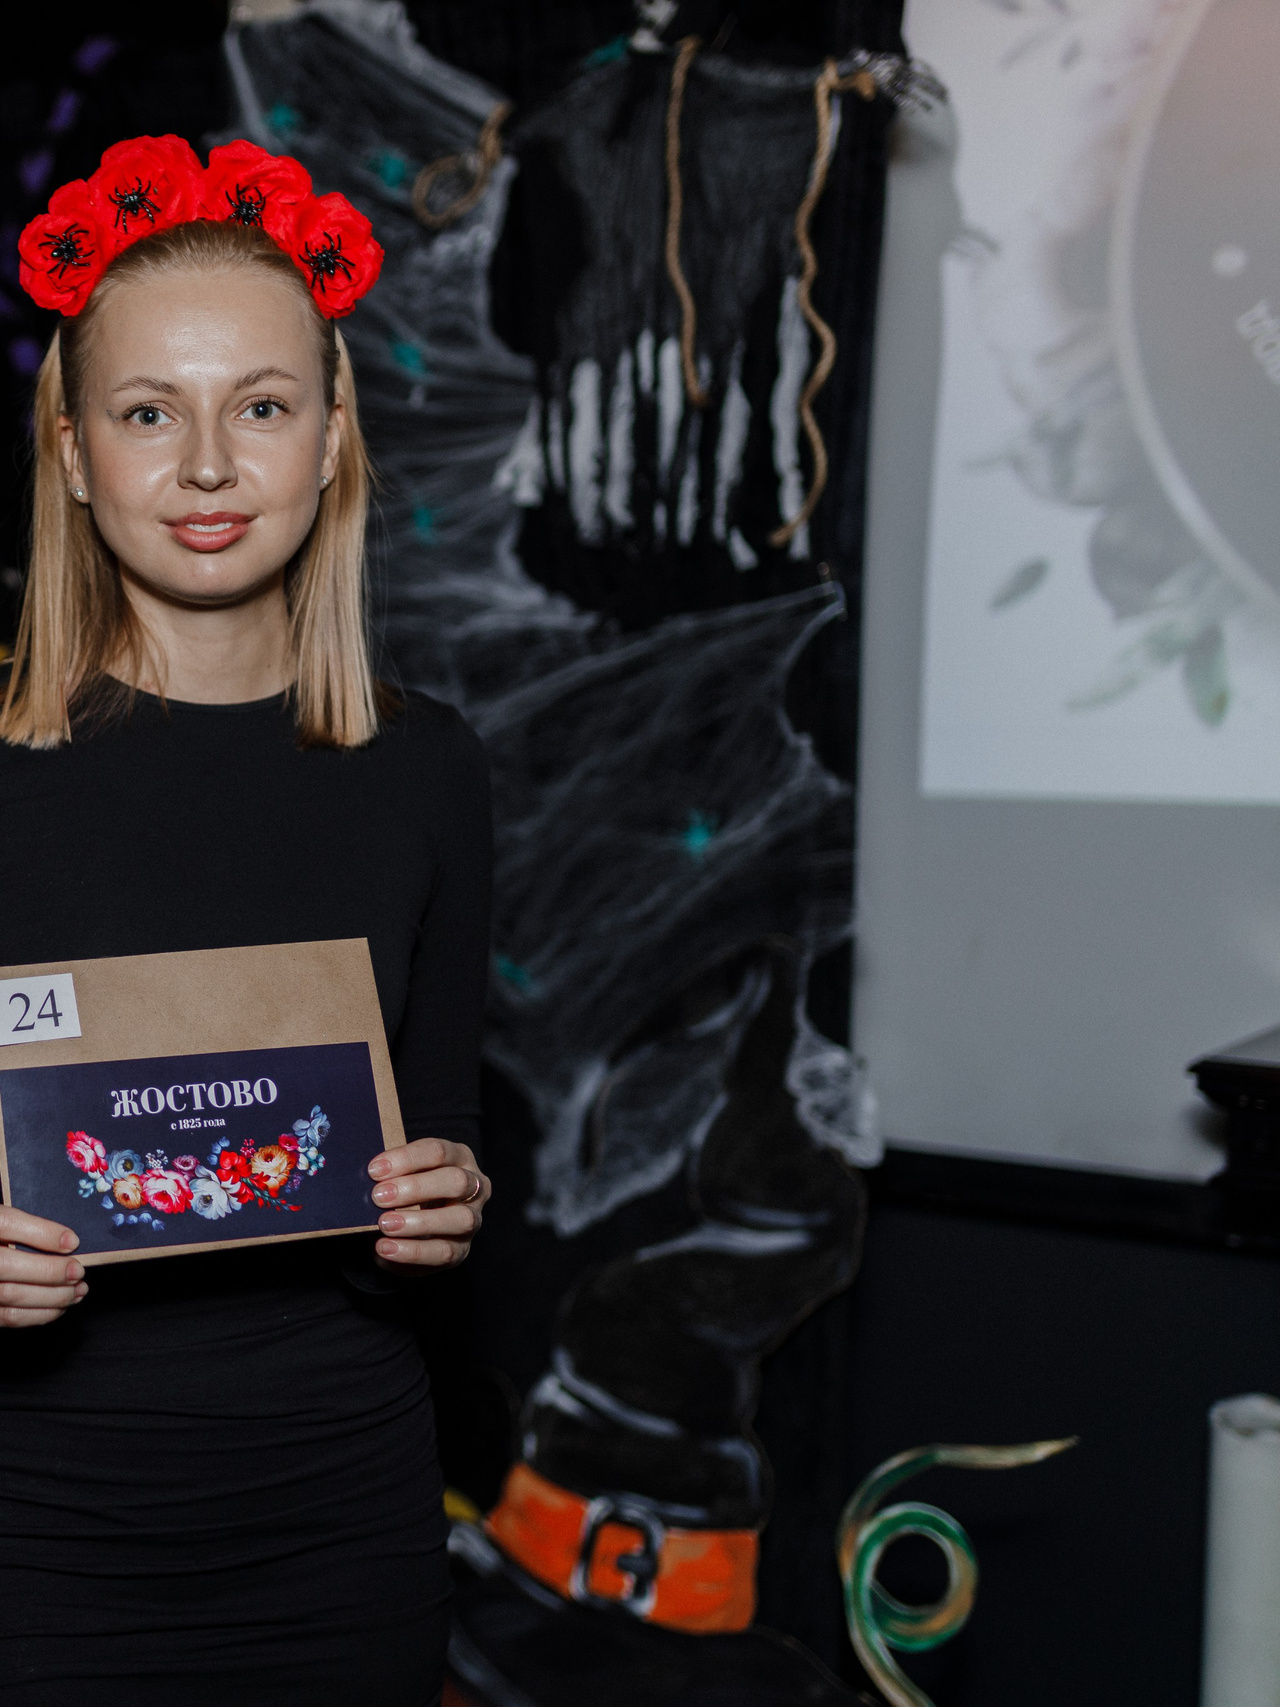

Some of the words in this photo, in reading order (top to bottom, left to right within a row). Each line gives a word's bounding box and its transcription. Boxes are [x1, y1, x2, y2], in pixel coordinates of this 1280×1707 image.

[8, 989, 63, 1032] 24
[111, 1077, 278, 1118] ЖОСТОВО
[170, 1121, 177, 1130] с
[178, 1118, 201, 1130] 1825
[203, 1116, 226, 1129] года
